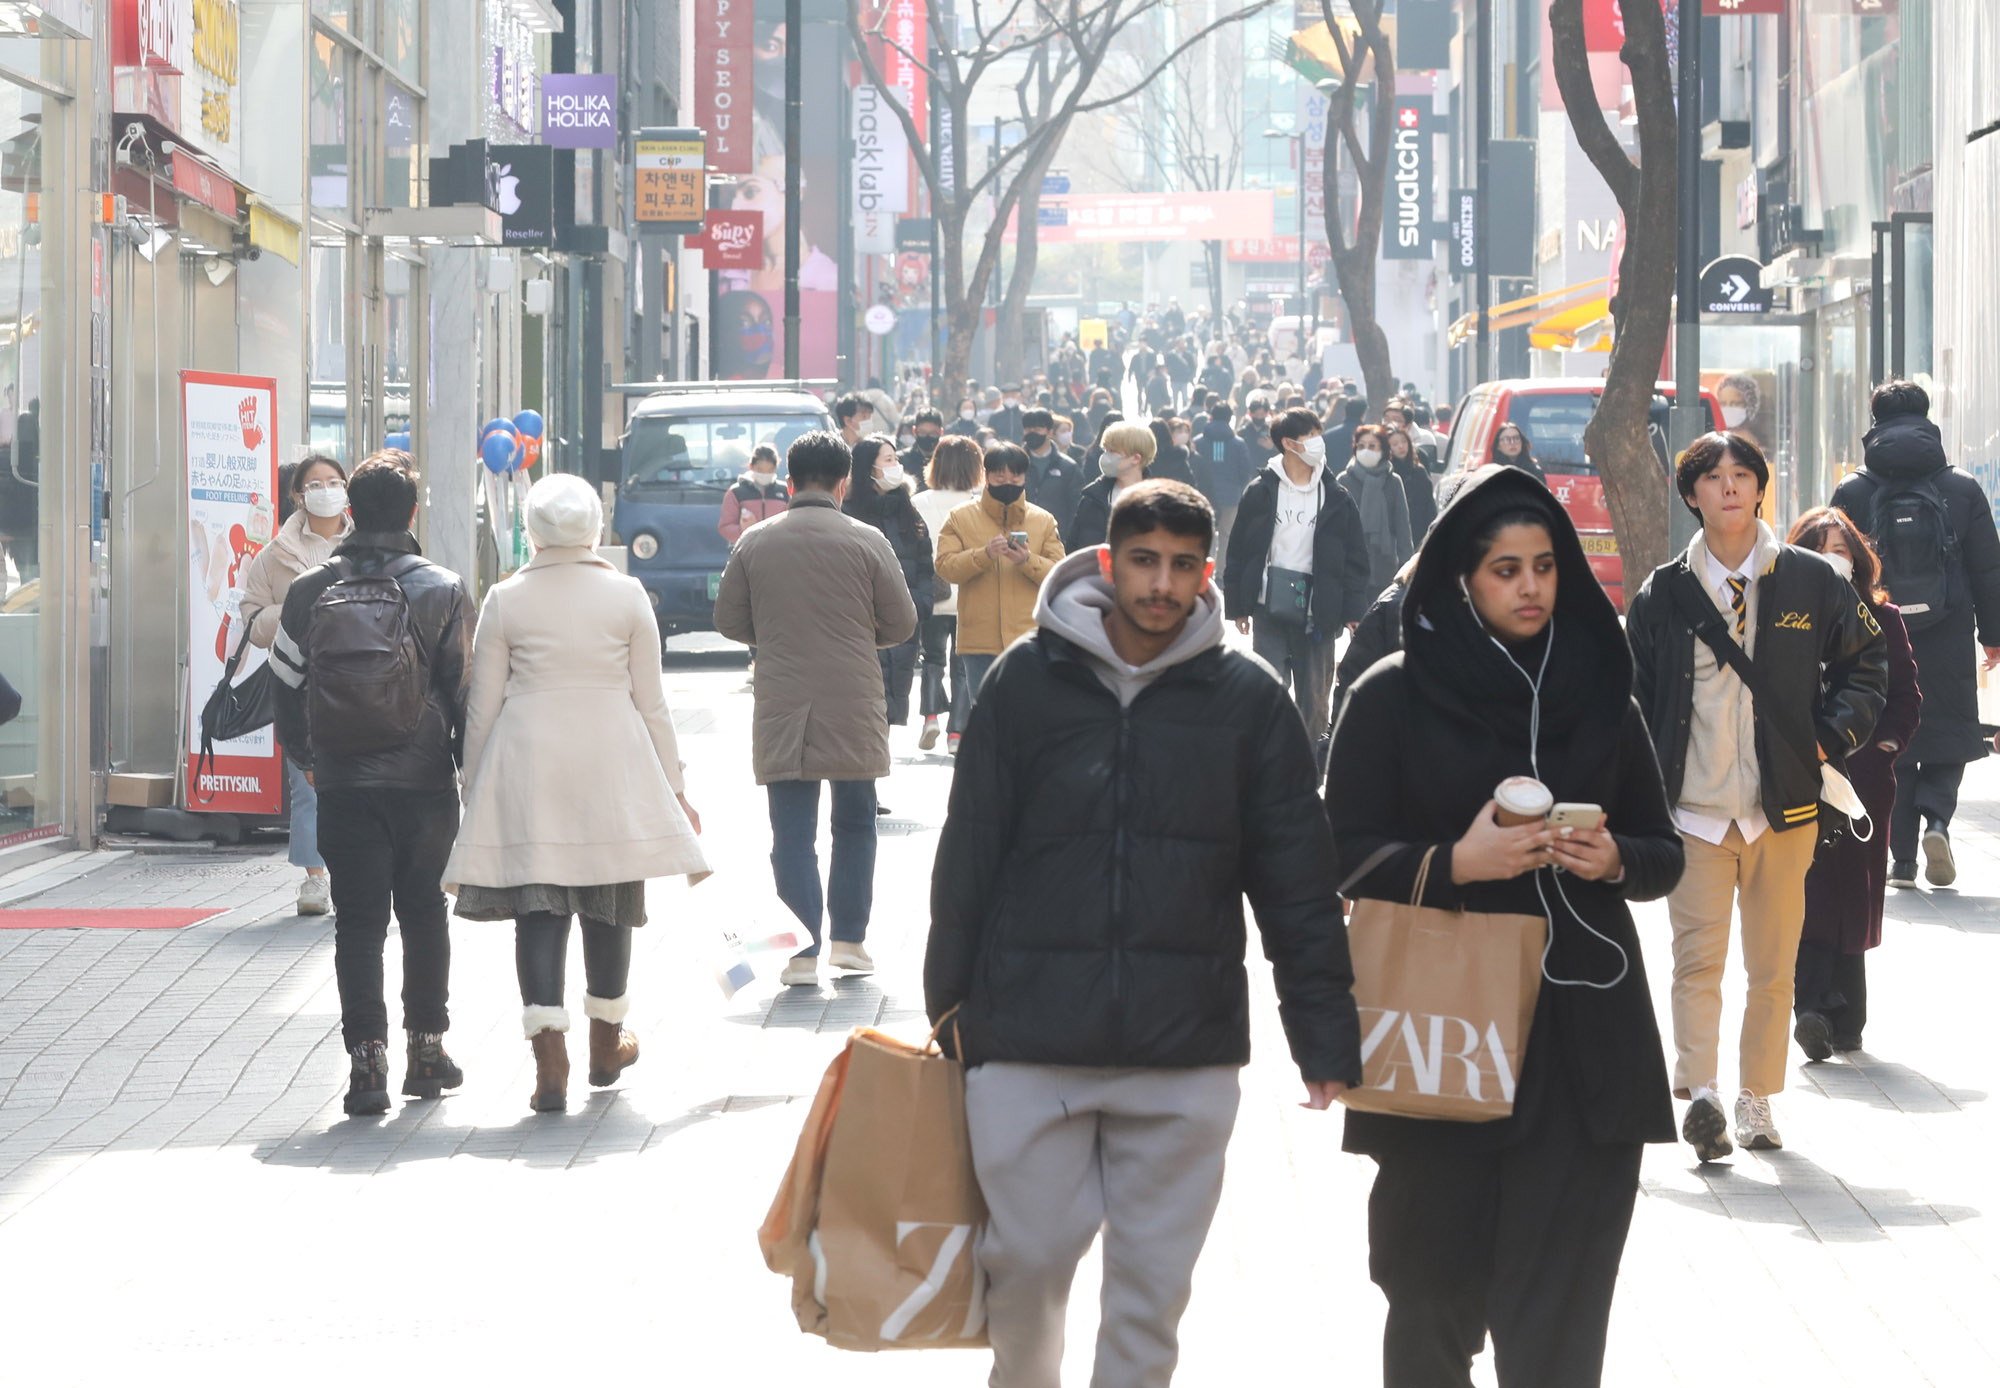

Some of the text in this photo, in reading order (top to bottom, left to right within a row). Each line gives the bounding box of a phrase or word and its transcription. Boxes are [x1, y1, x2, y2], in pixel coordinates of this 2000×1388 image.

[547, 95, 611, 111] HOLIKA
[714, 48, 732, 153] SEOUL
[547, 112, 611, 127] HOLIKA
[858, 85, 884, 211] masklab
[645, 171, 697, 191] 차앤박
[1395, 128, 1420, 248] swatch
[644, 192, 696, 209] 피부과
[505, 228, 544, 240] Reseller
[1461, 195, 1474, 267] SKINFOOD
[1709, 302, 1762, 312] CONVERSE
[241, 410, 255, 424] HIT
[205, 490, 222, 501] FOOT
[223, 492, 249, 503] PEELING
[1775, 611, 1813, 631] Lila
[1356, 1005, 1516, 1103] ZARA
